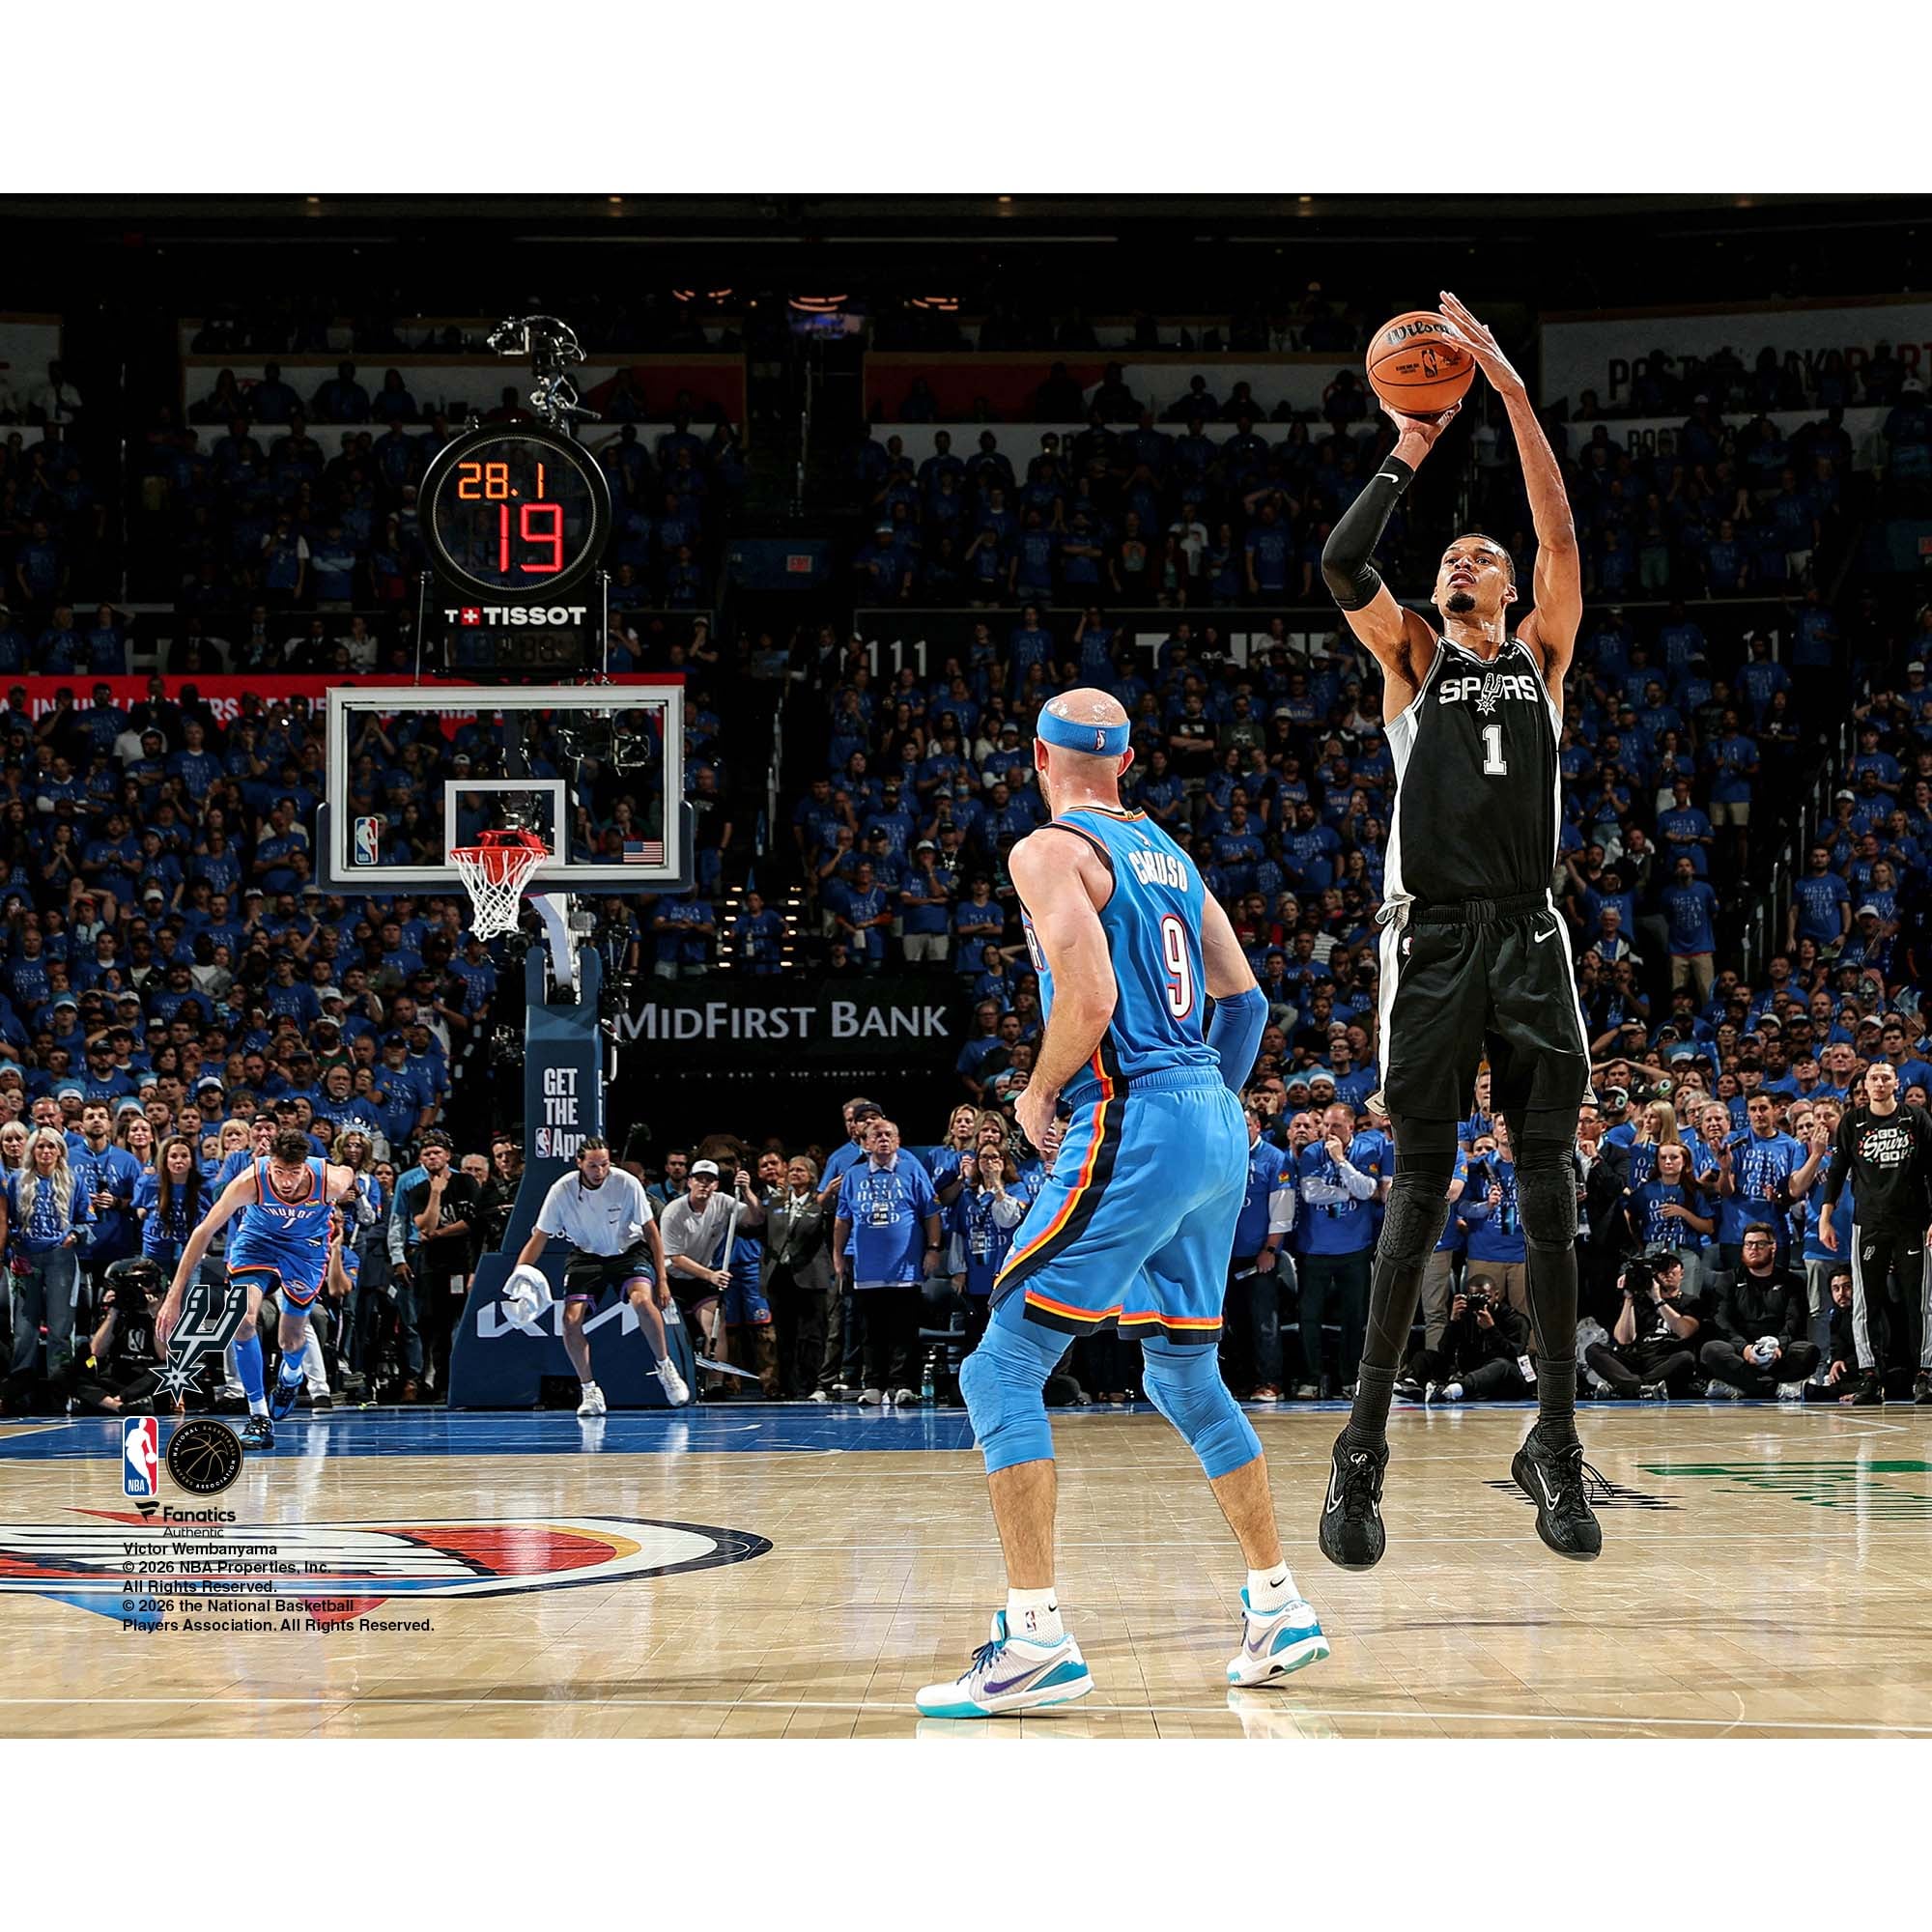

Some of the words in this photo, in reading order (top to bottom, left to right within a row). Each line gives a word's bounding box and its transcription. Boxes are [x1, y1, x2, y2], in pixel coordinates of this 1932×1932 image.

[458, 462, 545, 500] 28.1
[498, 502, 564, 573] 19
[444, 609, 459, 623] T
[483, 607, 587, 626] TISSOT
[1438, 672, 1539, 715] SPURS
[1482, 724, 1507, 776] 1
[1127, 850, 1188, 893] CRUSO
[1161, 913, 1195, 1021] 9
[831, 1001, 950, 1037] BANK
[544, 1067, 579, 1095] GET
[543, 1097, 579, 1125] THE
[1862, 1133, 1910, 1159] Spurs
